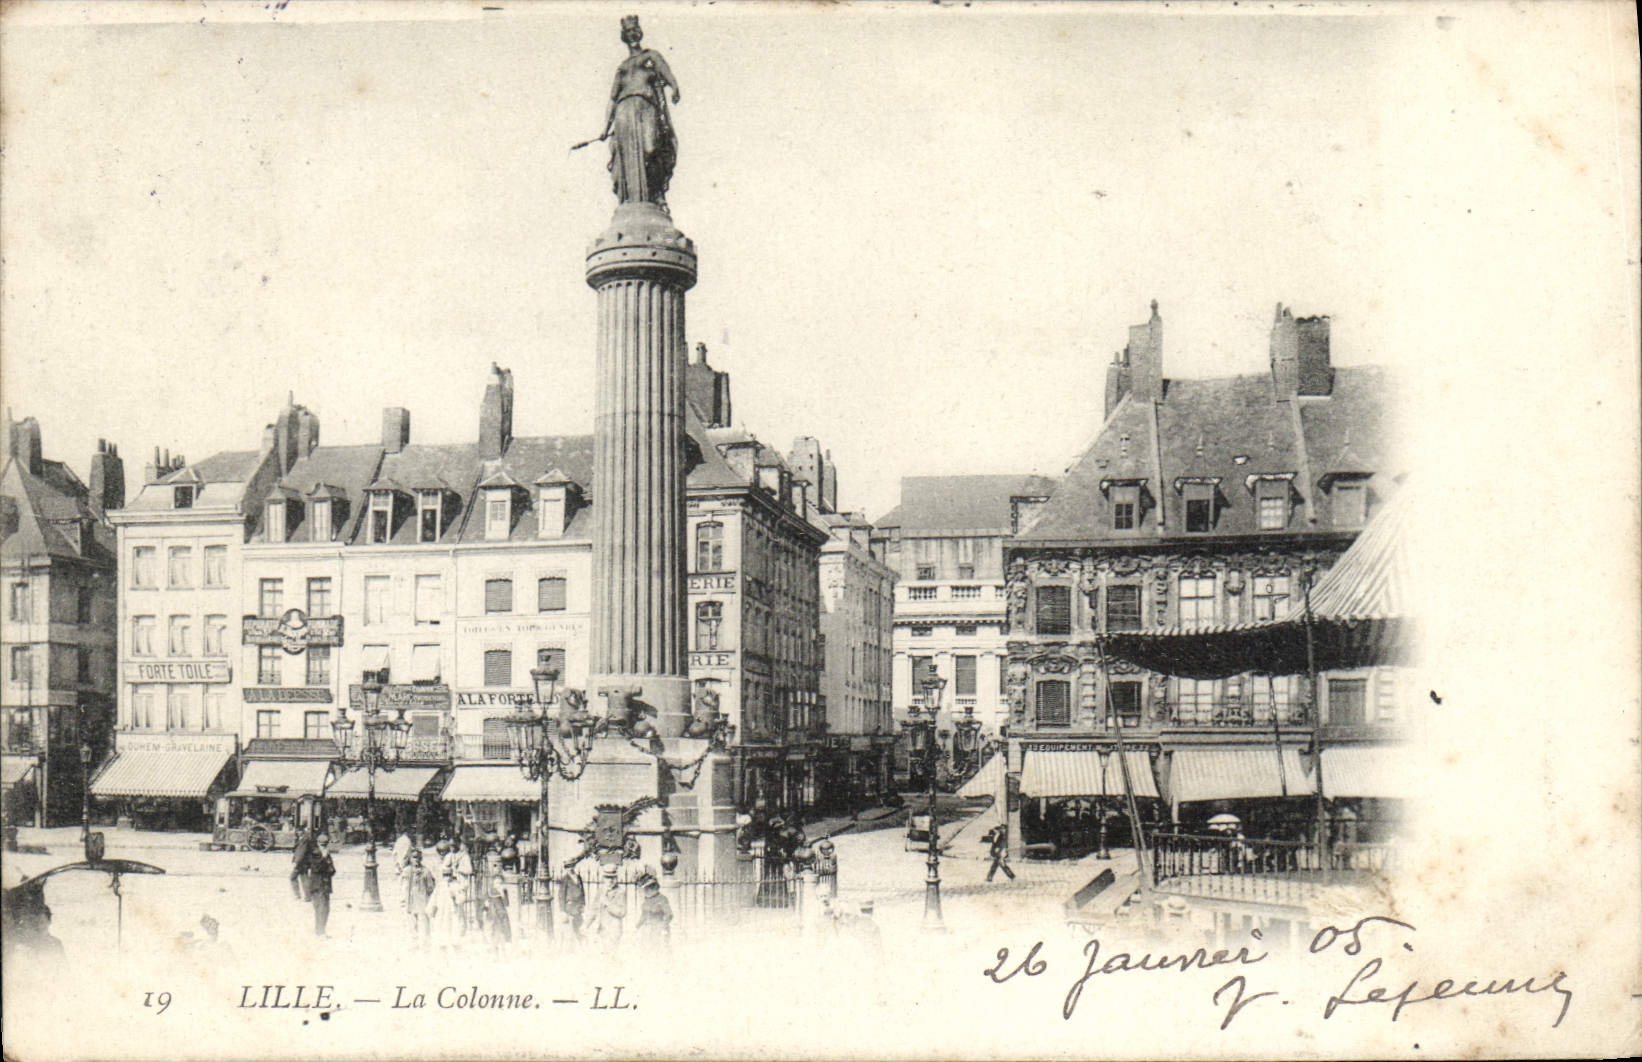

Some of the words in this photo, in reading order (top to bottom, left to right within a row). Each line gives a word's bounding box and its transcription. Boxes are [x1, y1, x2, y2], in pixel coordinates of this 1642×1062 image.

[138, 664, 176, 679] FORTE
[178, 664, 212, 679] TOILE
[457, 693, 467, 705] A
[488, 692, 534, 705] FORTE
[983, 941, 1048, 984] 26
